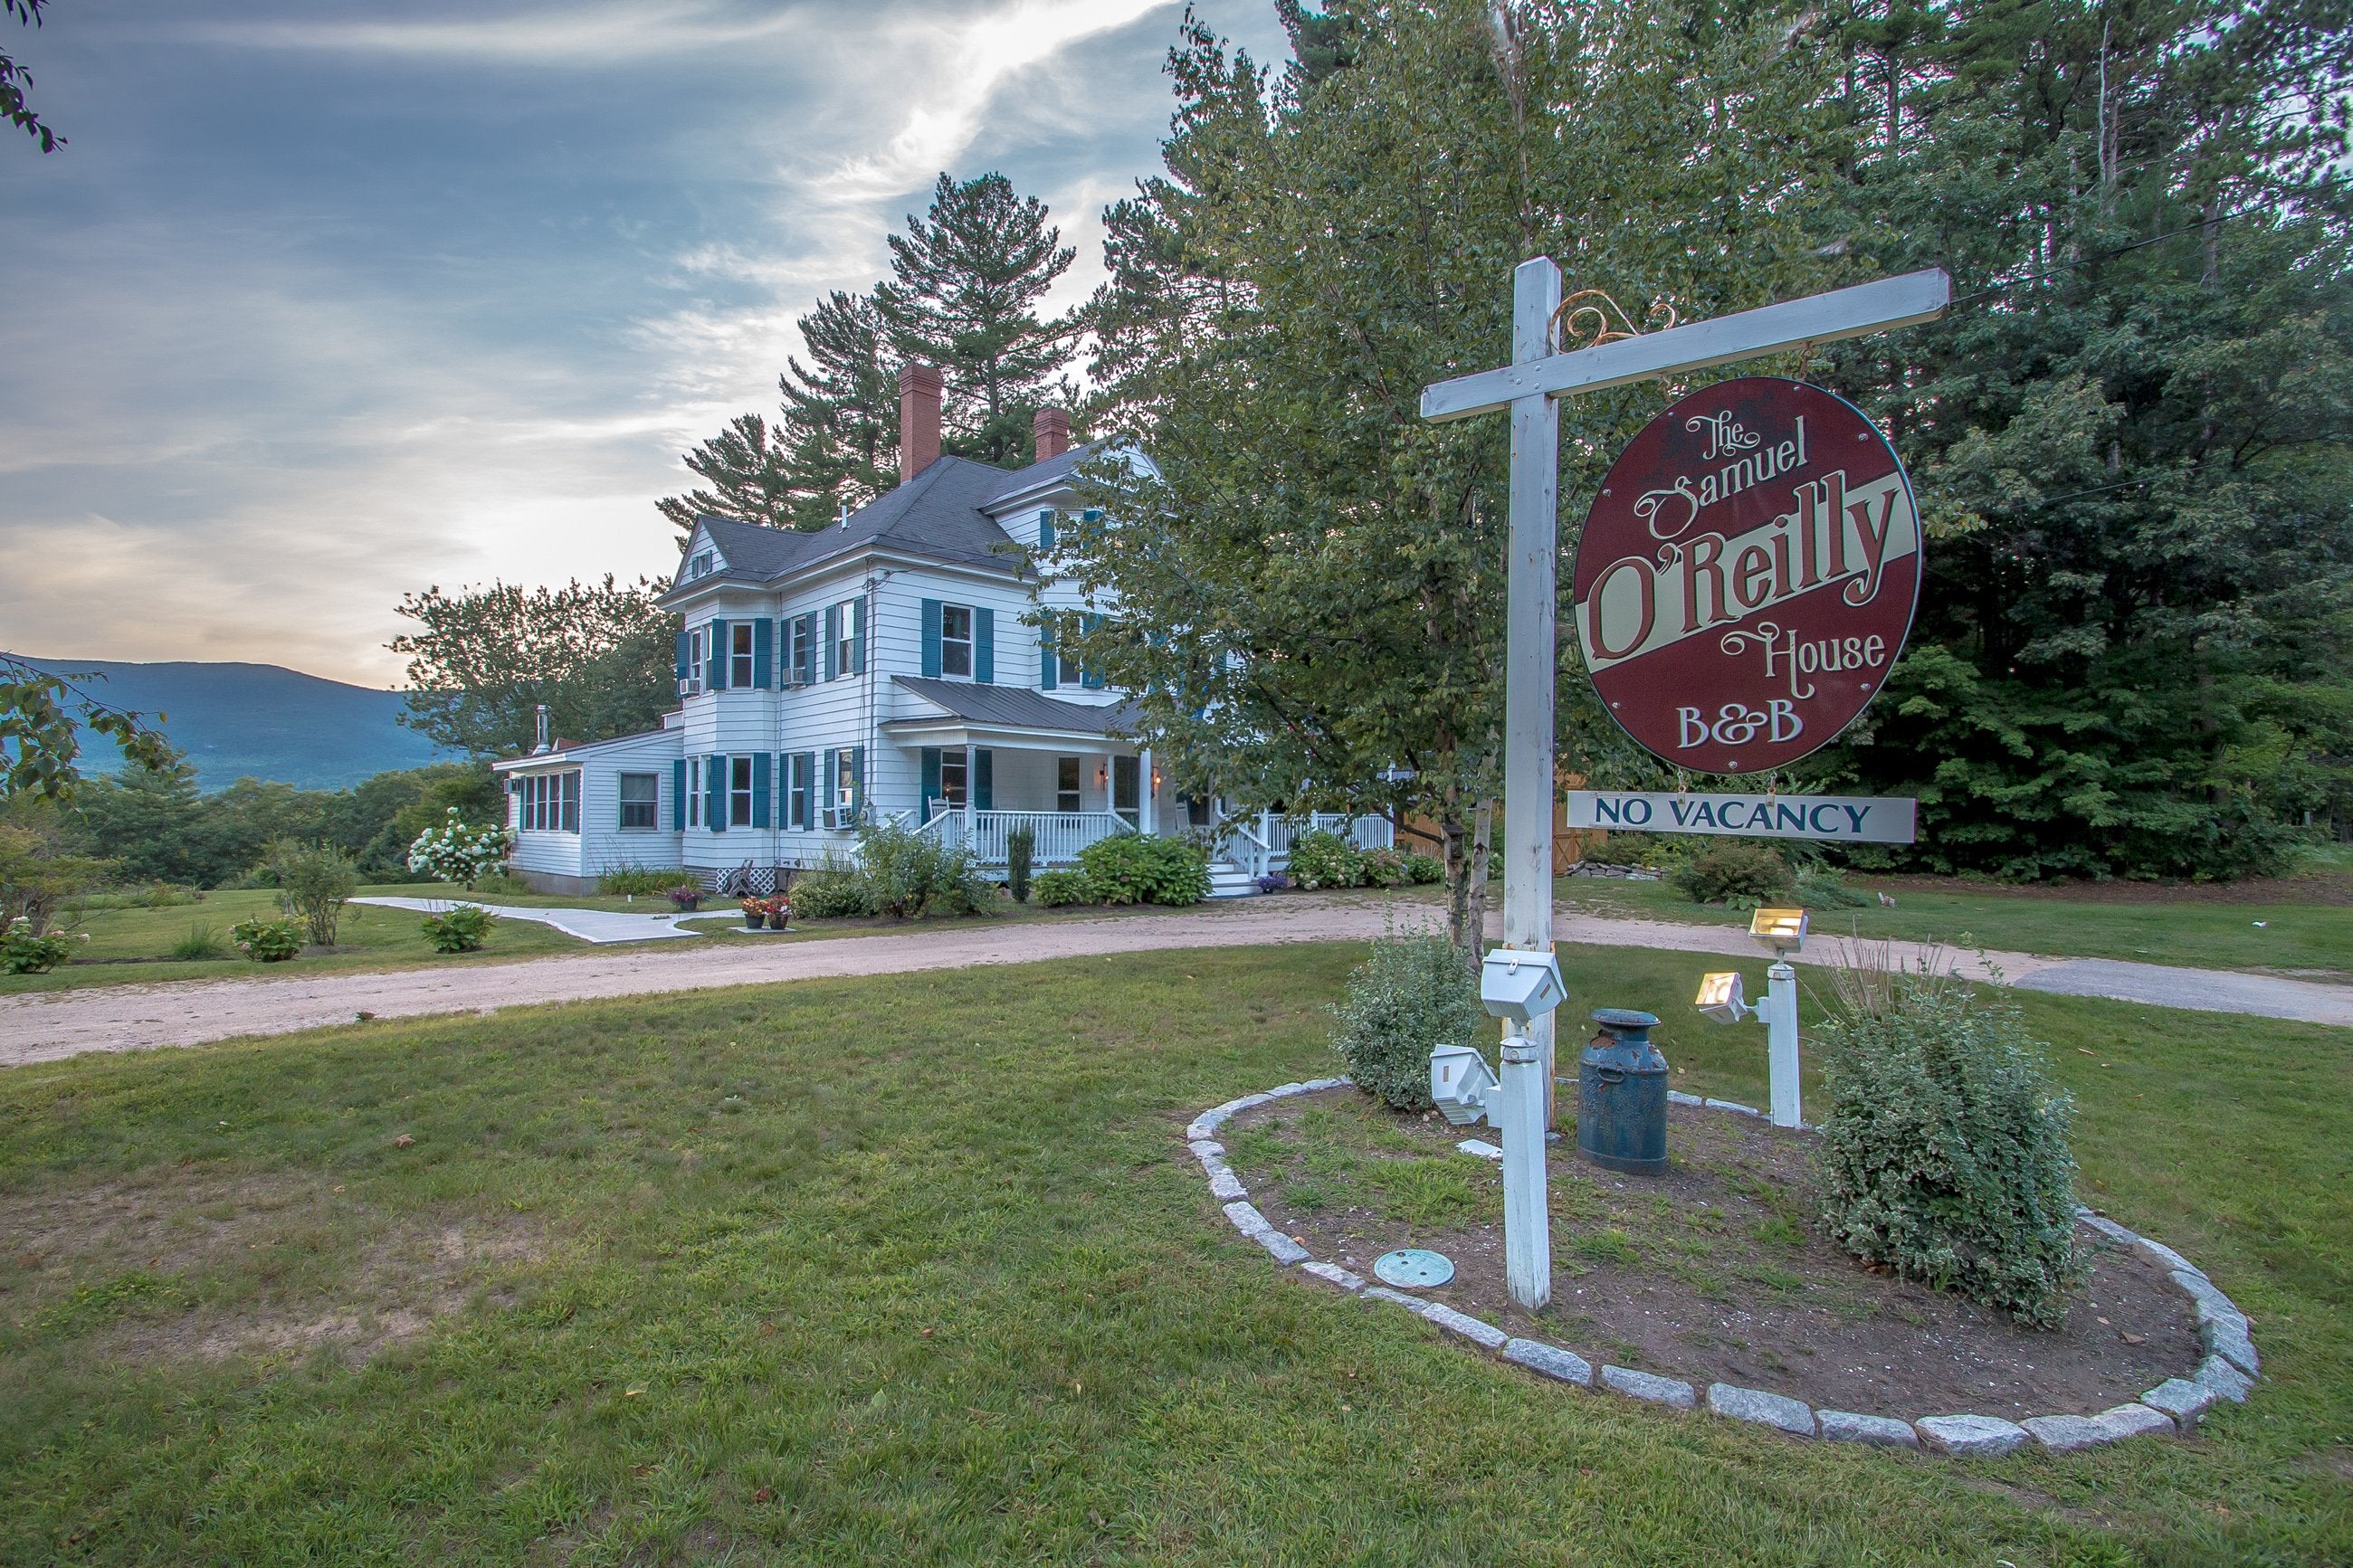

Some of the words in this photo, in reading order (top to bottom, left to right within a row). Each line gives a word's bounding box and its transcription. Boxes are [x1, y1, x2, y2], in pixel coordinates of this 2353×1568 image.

[1686, 410, 1760, 460] The
[1634, 415, 1807, 540] Samuel
[1720, 622, 1885, 699] House
[1676, 698, 1804, 748] B&B
[1595, 797, 1653, 826] NO
[1669, 799, 1872, 834] VACANCY
